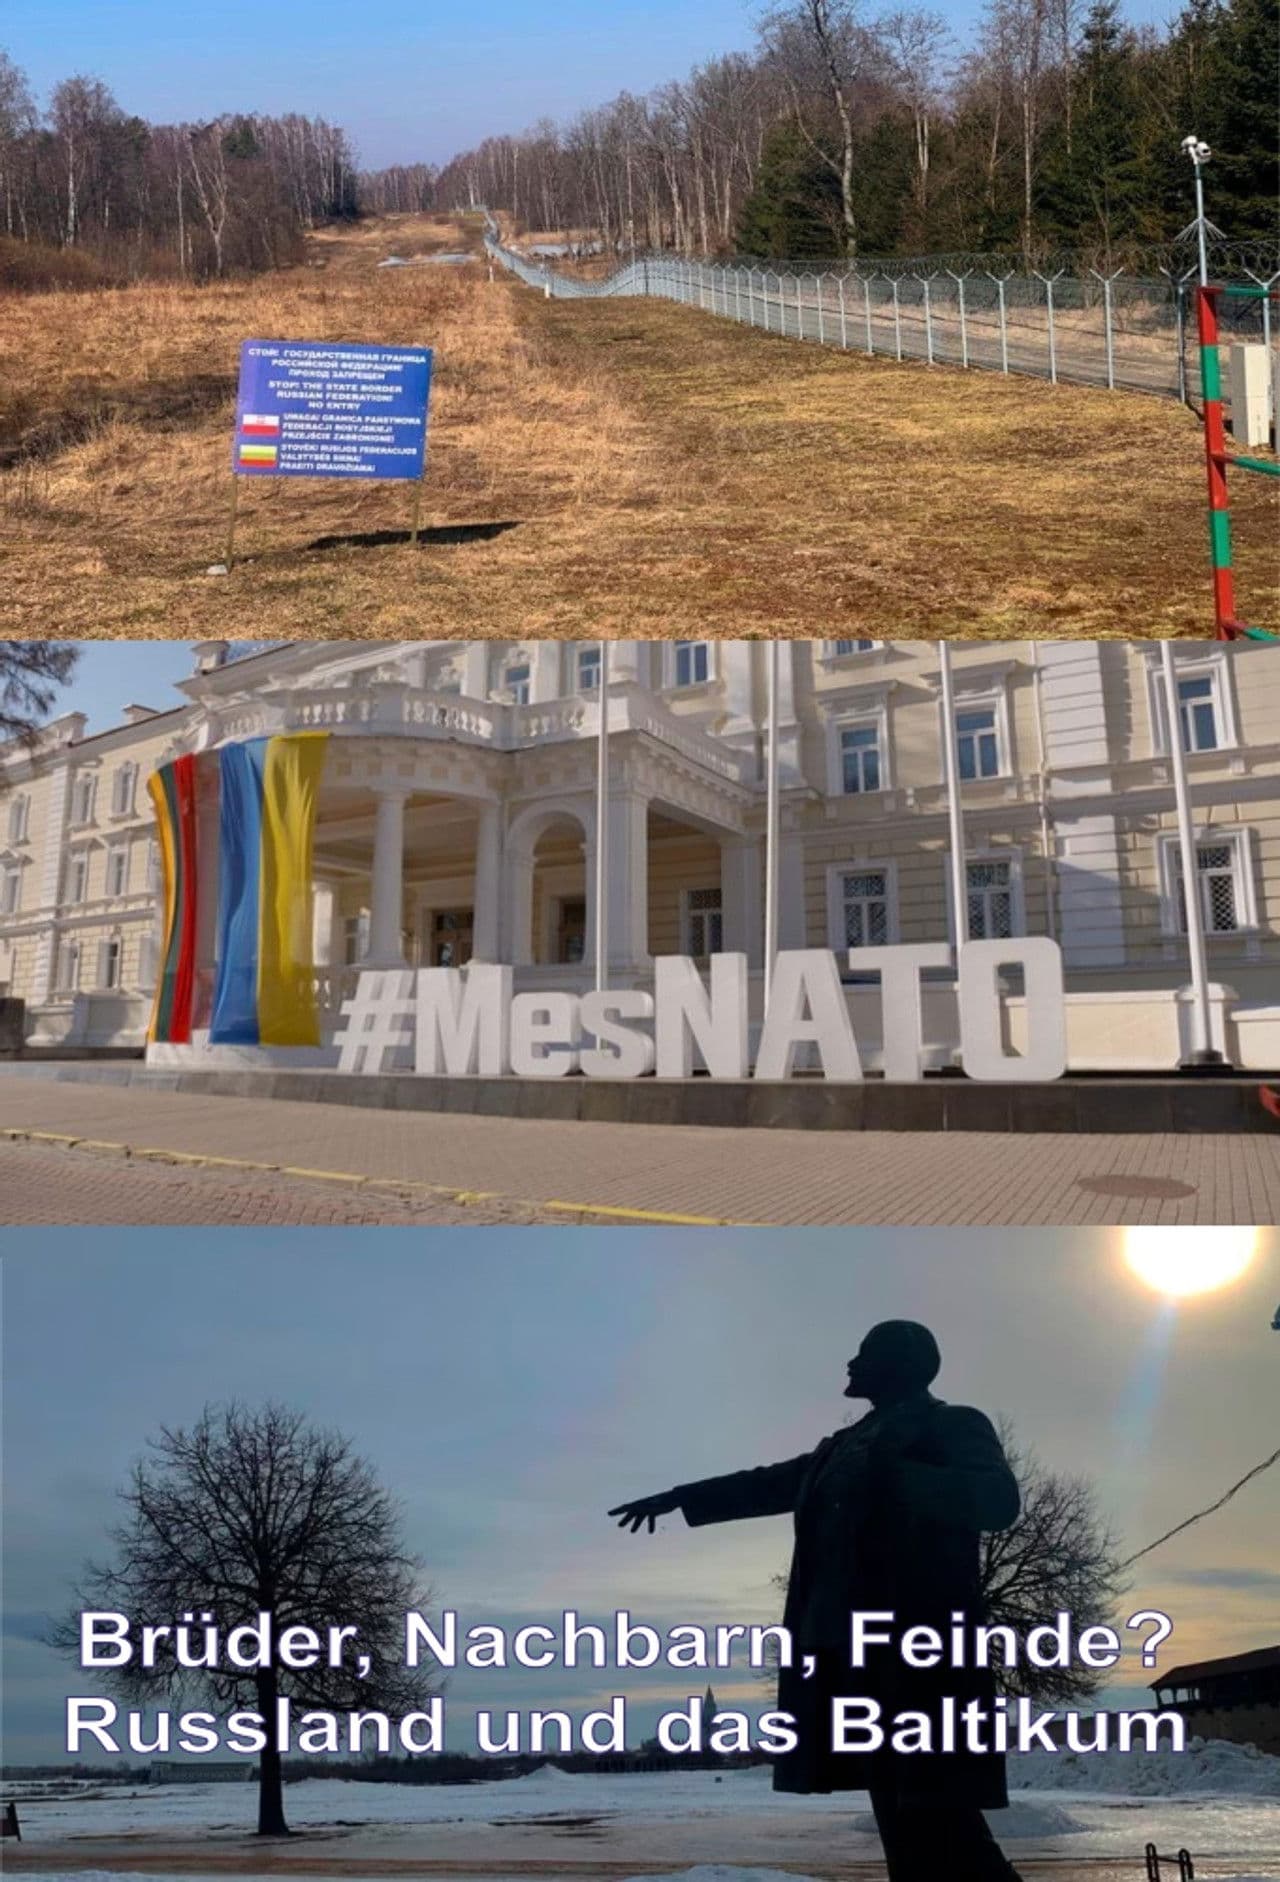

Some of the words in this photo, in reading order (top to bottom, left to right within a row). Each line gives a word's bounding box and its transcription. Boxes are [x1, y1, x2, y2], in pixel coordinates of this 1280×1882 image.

[284, 350, 378, 360] ГОСУДАРСТВЕННАЯ
[382, 354, 426, 364] ГРАНИЦА
[272, 359, 338, 368] РОССИЙСКОЙ
[289, 369, 329, 378] ПРОХОД
[269, 380, 300, 388] STOP!
[302, 382, 322, 390] THE
[326, 383, 358, 391] STATE
[360, 384, 402, 392] BORDER
[277, 391, 323, 399] RUSSIAN
[327, 401, 360, 410] ENTRY
[322, 414, 362, 422] GRANICA
[337, 936, 1066, 1083] #MesNATO
